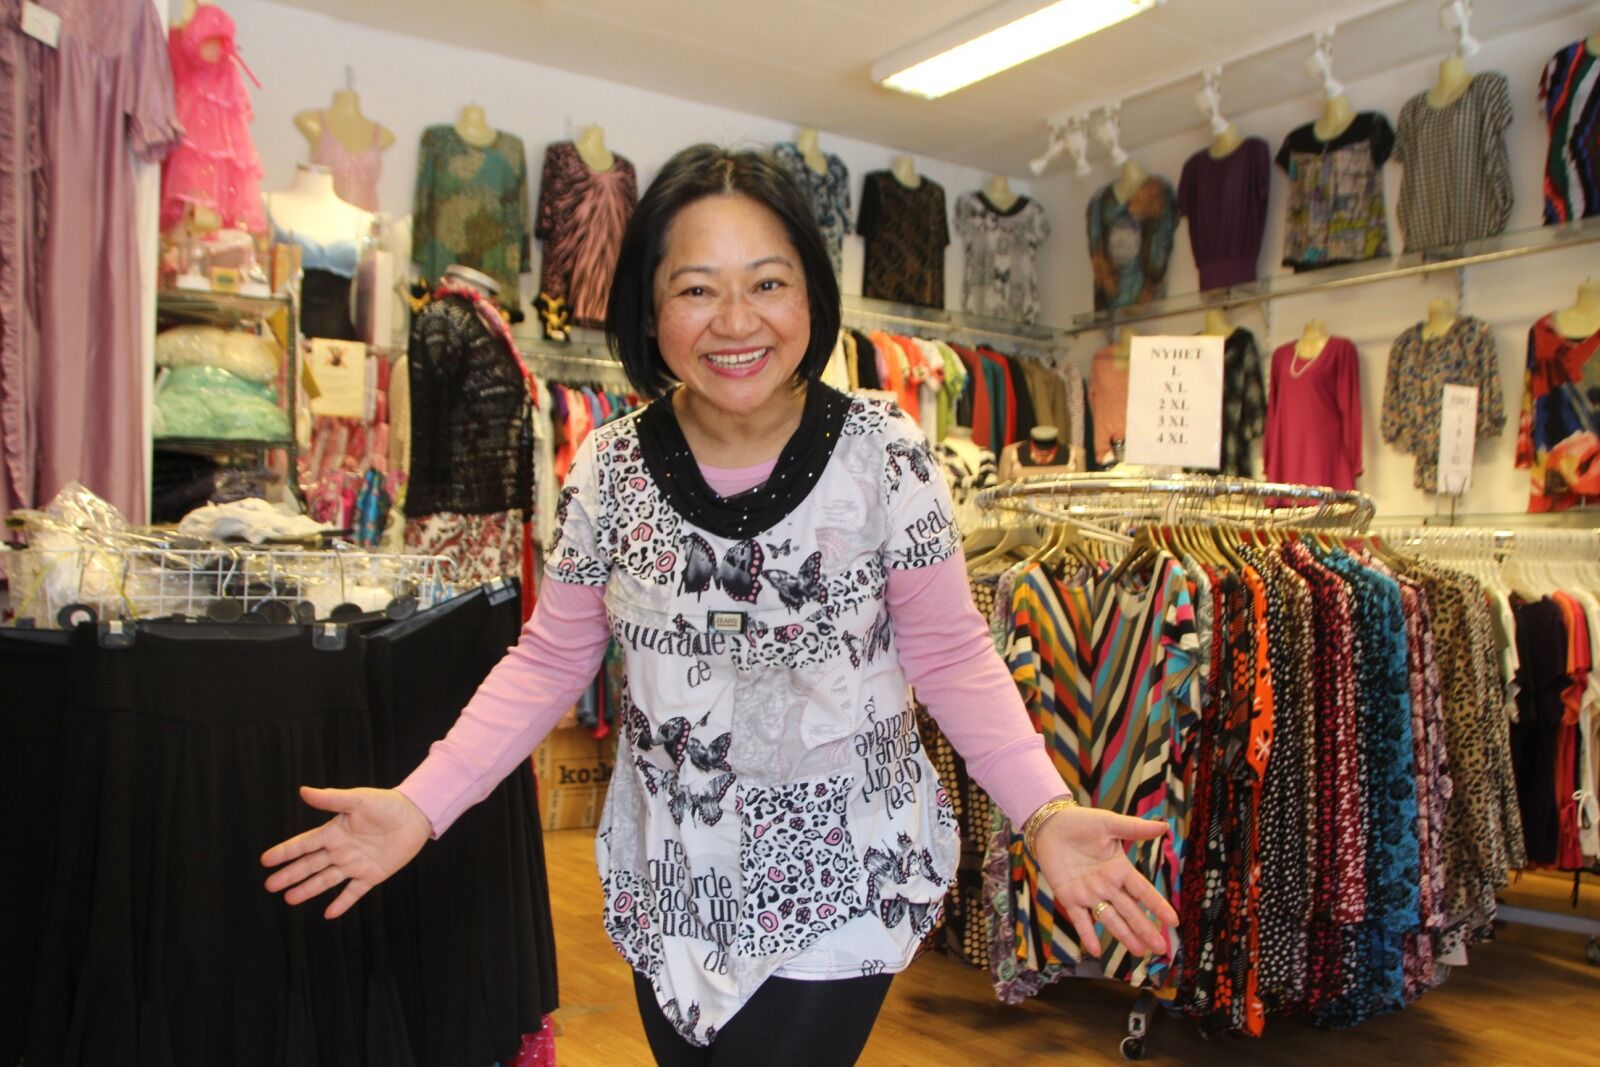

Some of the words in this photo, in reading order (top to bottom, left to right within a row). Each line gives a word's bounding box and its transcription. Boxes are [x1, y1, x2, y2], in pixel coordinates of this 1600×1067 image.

[1151, 347, 1202, 359] NYHET
[1171, 365, 1181, 376] L
[1159, 398, 1165, 410] 2
[1170, 399, 1189, 410] XL
[1169, 415, 1189, 427] XL
[1168, 432, 1188, 444] XL
